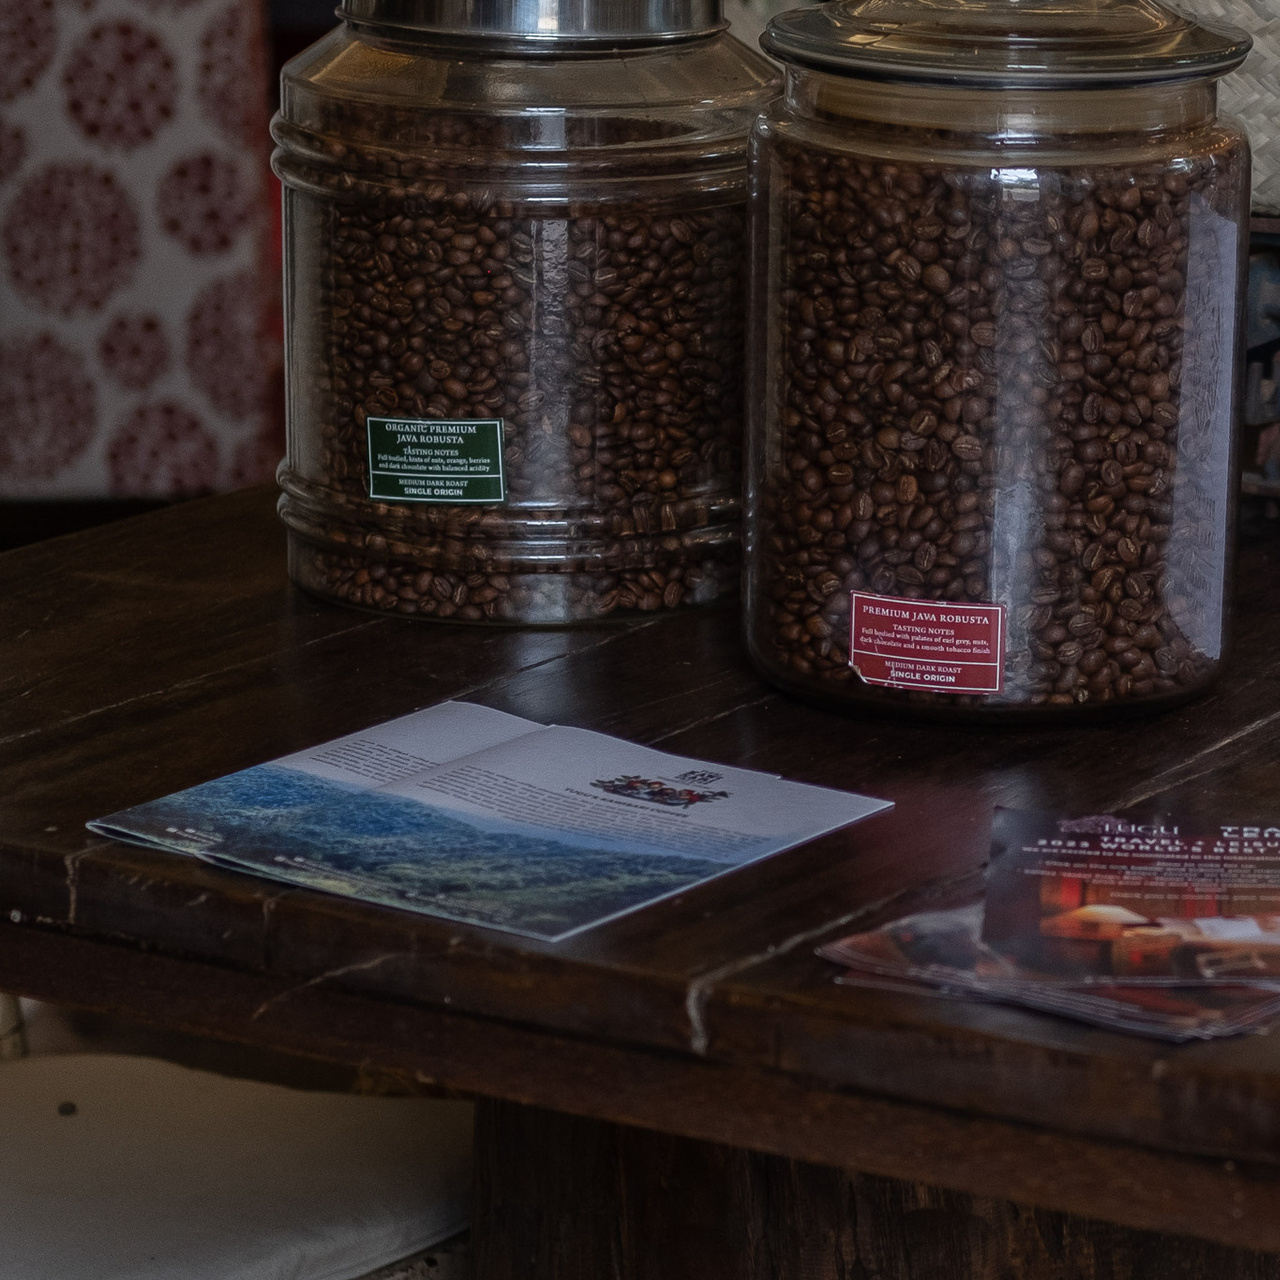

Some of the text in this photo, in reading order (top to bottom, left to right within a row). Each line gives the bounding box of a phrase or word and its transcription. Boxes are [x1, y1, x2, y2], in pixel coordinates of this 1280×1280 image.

[385, 423, 477, 434] ORGANIC PREMIUM
[396, 434, 464, 444] JAVA ROBUSTA
[401, 463, 427, 471] chocolate
[469, 465, 491, 473] acidity
[404, 487, 463, 496] SINGLE ORIGIN
[863, 605, 989, 625] PREMIUM JAVA ROBUSTA
[893, 624, 926, 634] TASTING
[874, 630, 895, 638] bodied
[895, 632, 910, 640] with
[910, 634, 933, 643] palates
[956, 638, 971, 646] grey,
[859, 636, 873, 644] dark
[874, 638, 902, 648] chocolate
[903, 641, 915, 649] and
[946, 645, 971, 653] tobacco
[885, 660, 962, 674] MEDIUM DARK ROAST
[891, 670, 956, 683] SINGLE ORIGIN
[1100, 836, 1184, 846] TRAVEL
[1100, 842, 1202, 852] WORLD'S
